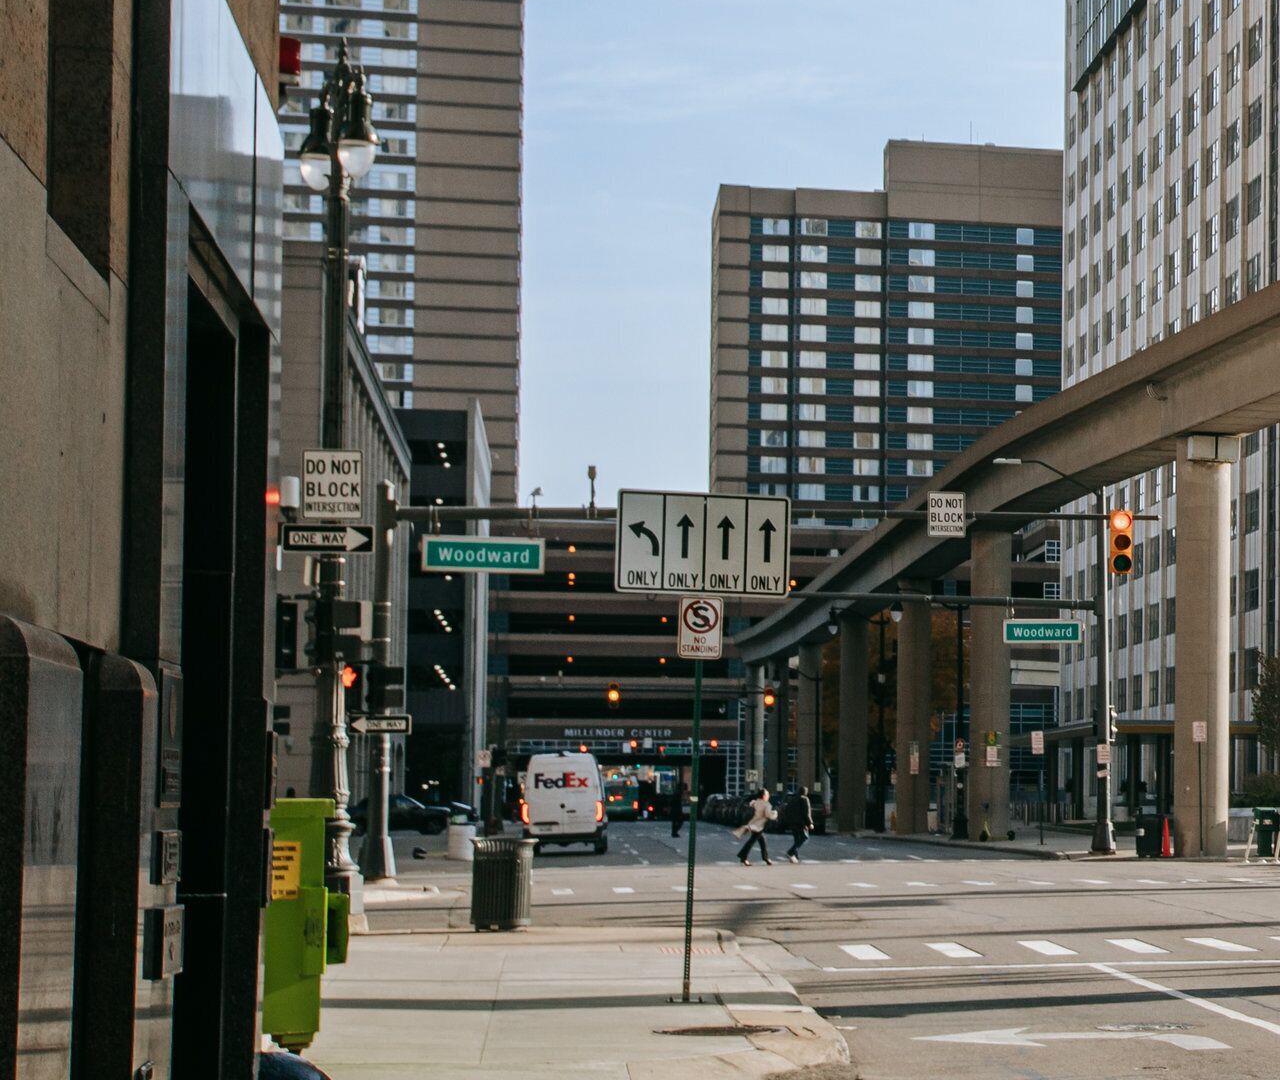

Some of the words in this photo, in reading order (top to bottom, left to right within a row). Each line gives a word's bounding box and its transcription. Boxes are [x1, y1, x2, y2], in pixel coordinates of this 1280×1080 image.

[306, 459, 326, 475] DO
[331, 459, 360, 475] NOT
[306, 482, 360, 497] BLOCK
[305, 502, 360, 513] INTERSECTION
[930, 498, 943, 508] DO
[945, 498, 962, 509] NOT
[930, 512, 963, 523] BLOCK
[292, 533, 317, 544] ONE
[321, 533, 346, 544] WAY
[438, 547, 530, 564] Woodward
[627, 570, 658, 586] ONLY
[668, 572, 699, 589] ONLY
[709, 573, 740, 589] ONLY
[751, 575, 781, 591] ONLY
[1013, 626, 1073, 638] Woodward
[693, 636, 707, 644] NO
[681, 644, 718, 654] STANDING
[564, 728, 624, 737] MILLENDER
[631, 728, 672, 737] CENTER
[534, 772, 589, 789] FedEx
